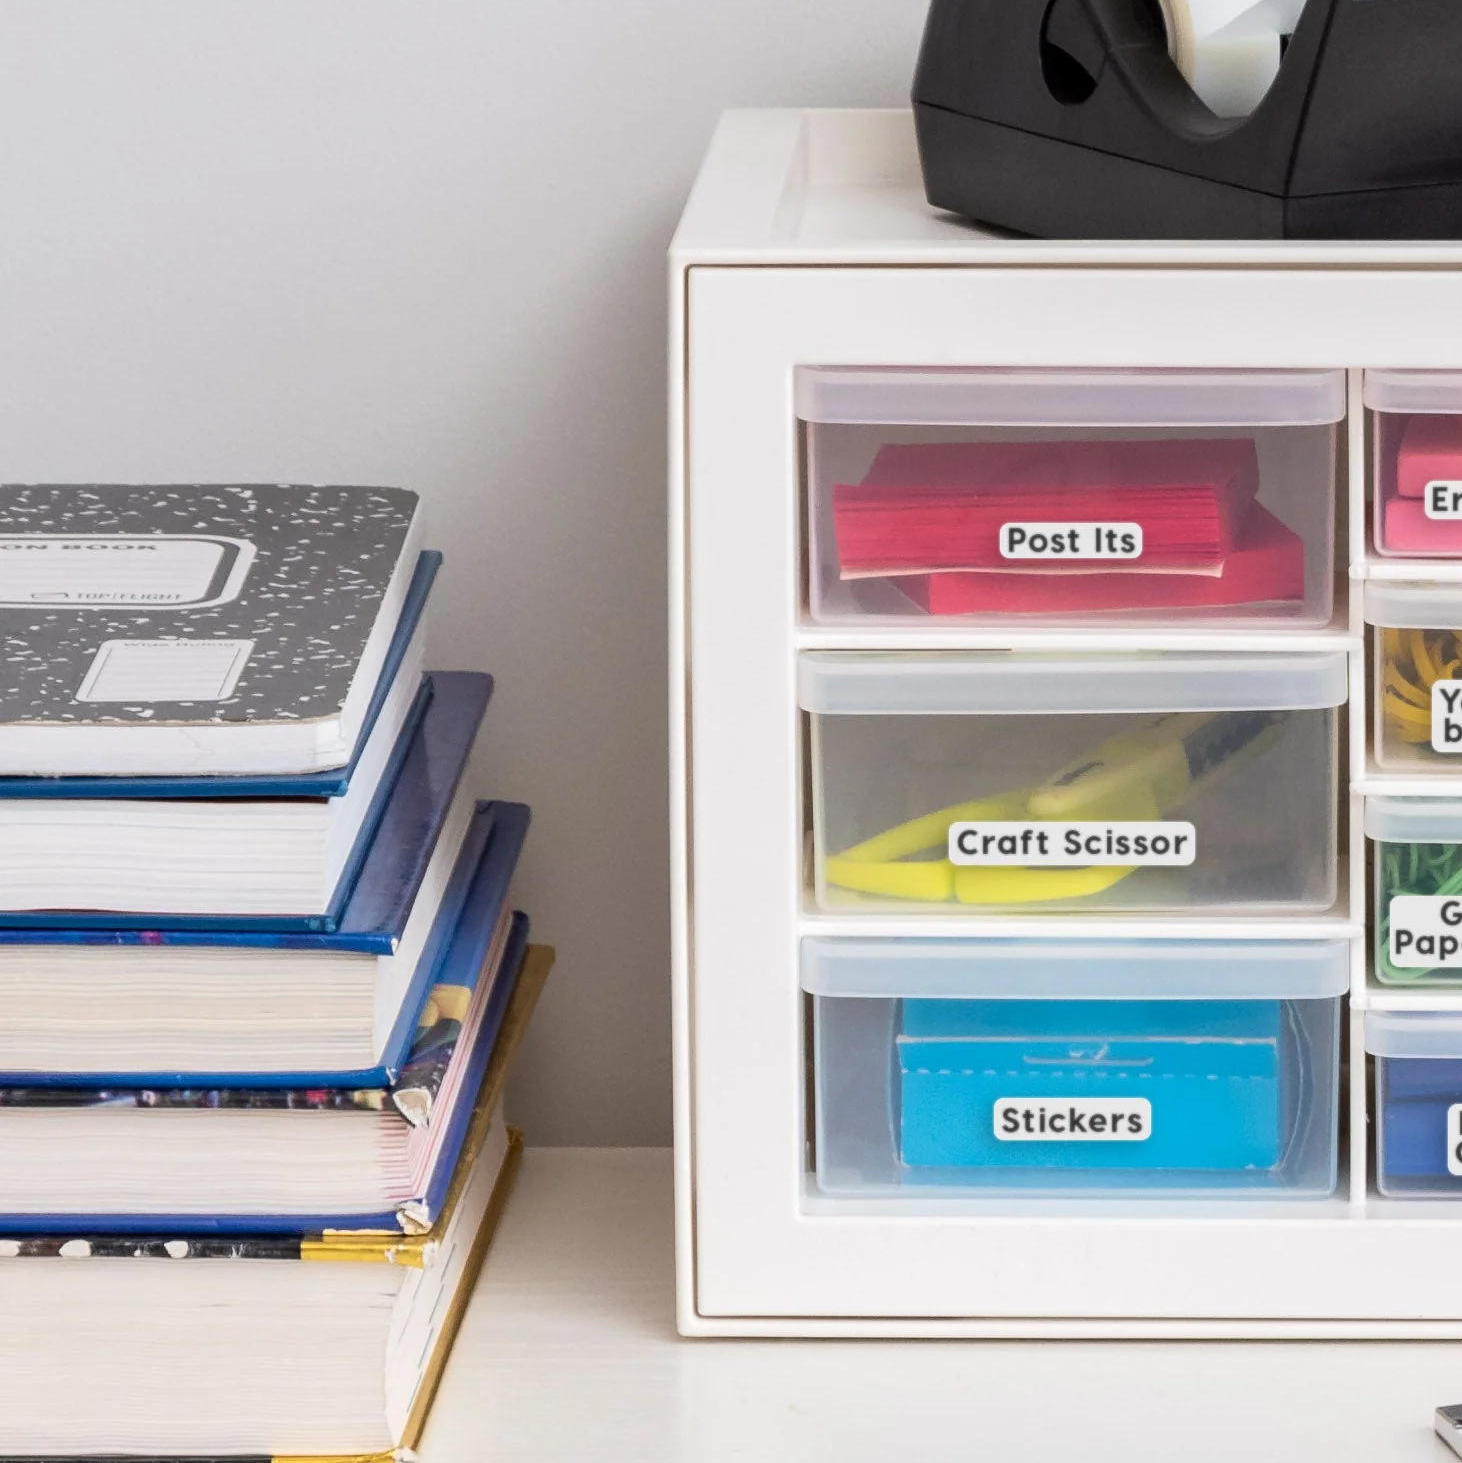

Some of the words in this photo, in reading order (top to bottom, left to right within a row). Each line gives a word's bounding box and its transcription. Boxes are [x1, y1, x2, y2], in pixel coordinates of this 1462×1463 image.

[1008, 527, 1080, 554] Post
[1095, 527, 1136, 554] Its
[957, 829, 1049, 855] Craft
[1064, 829, 1188, 856] Scissor
[1002, 1107, 1143, 1134] Stickers
